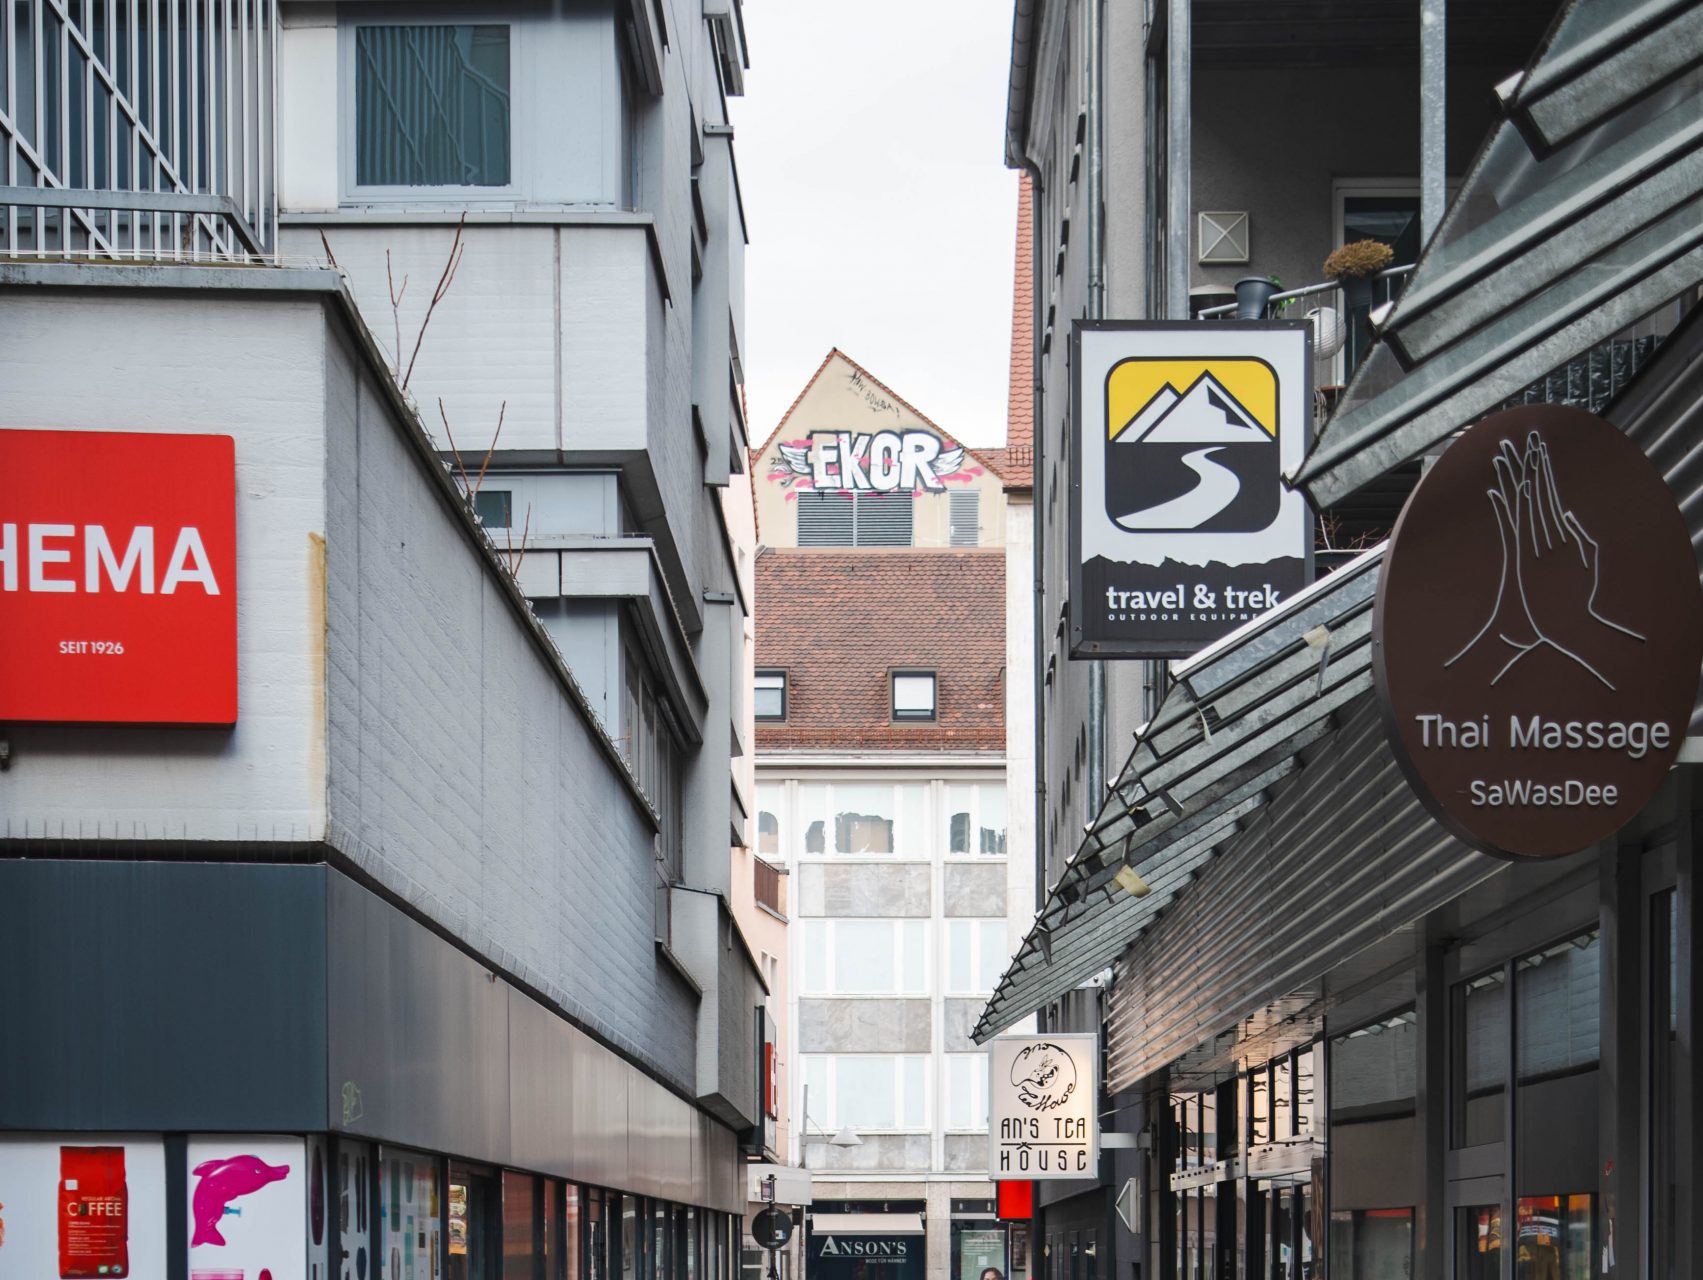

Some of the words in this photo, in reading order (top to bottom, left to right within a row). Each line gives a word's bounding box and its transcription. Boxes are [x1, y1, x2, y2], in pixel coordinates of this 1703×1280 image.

[807, 428, 947, 494] EKOR
[1106, 584, 1185, 609] travel
[1193, 584, 1216, 609] &
[1224, 584, 1280, 609] trek
[1108, 613, 1180, 621] OUTDOOR
[1190, 613, 1258, 621] EQUIPME
[59, 641, 88, 654] SEIT
[91, 641, 124, 654] 1926
[1415, 713, 1490, 748] Thai
[1510, 715, 1671, 758] Massage
[1470, 780, 1618, 806] SaWasDee
[820, 1235, 907, 1256] ANSON'S
